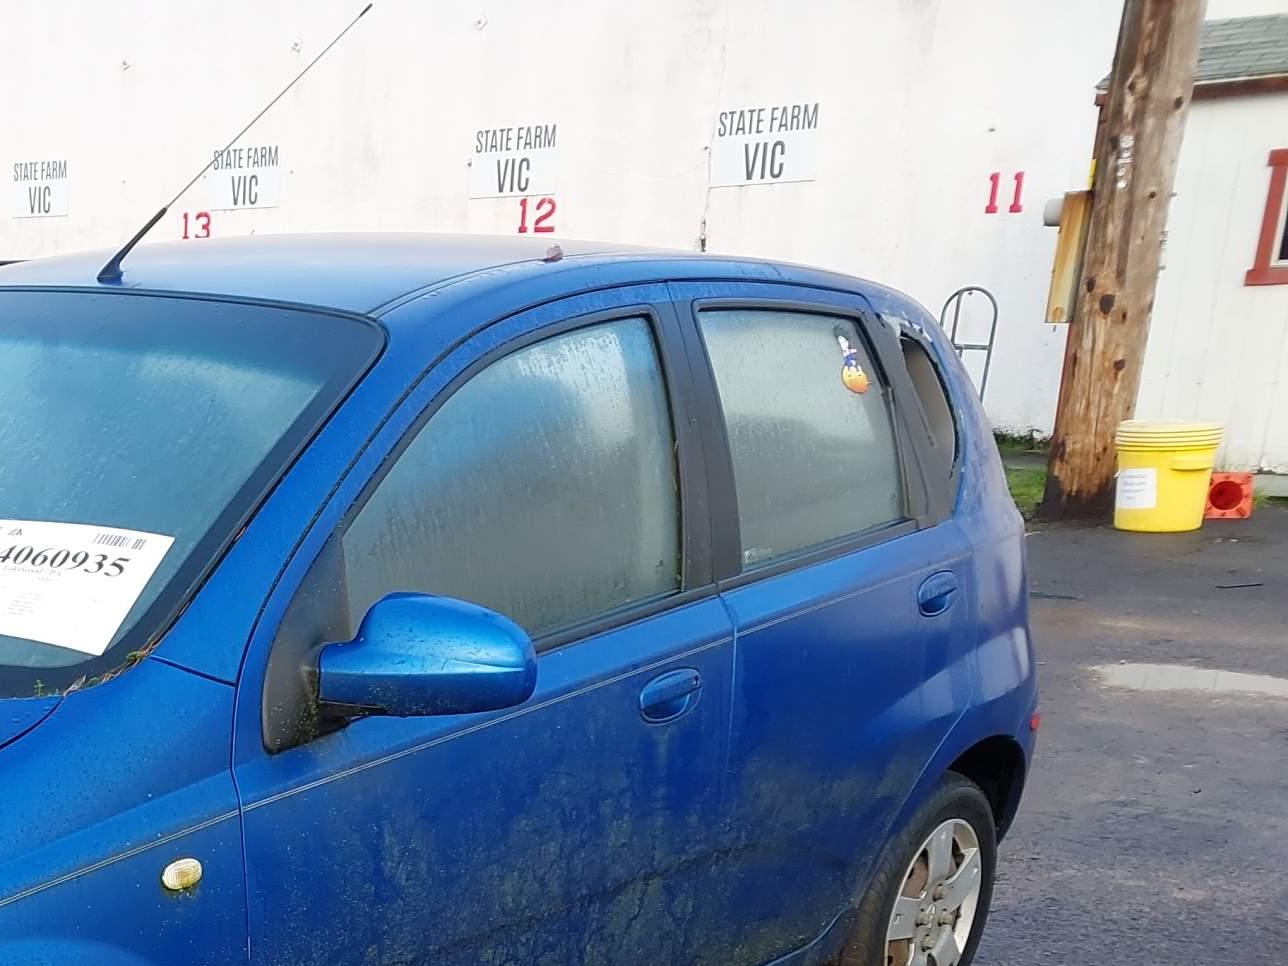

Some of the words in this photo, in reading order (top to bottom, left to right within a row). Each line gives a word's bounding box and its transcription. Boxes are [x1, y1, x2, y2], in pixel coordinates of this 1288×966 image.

[717, 106, 766, 138] STATE
[768, 102, 820, 132] FARM
[475, 127, 513, 154] STATE
[515, 124, 557, 151] FARM
[13, 161, 39, 182] STATE
[40, 159, 68, 181] FARM
[213, 147, 244, 171] STATE
[246, 144, 279, 169] FARM
[743, 139, 786, 181] VIC
[231, 174, 259, 206] VIC
[496, 156, 531, 194] VIC
[28, 185, 52, 215] VIC
[983, 171, 1026, 214] 11
[182, 211, 211, 240] 13
[517, 197, 557, 235] 12
